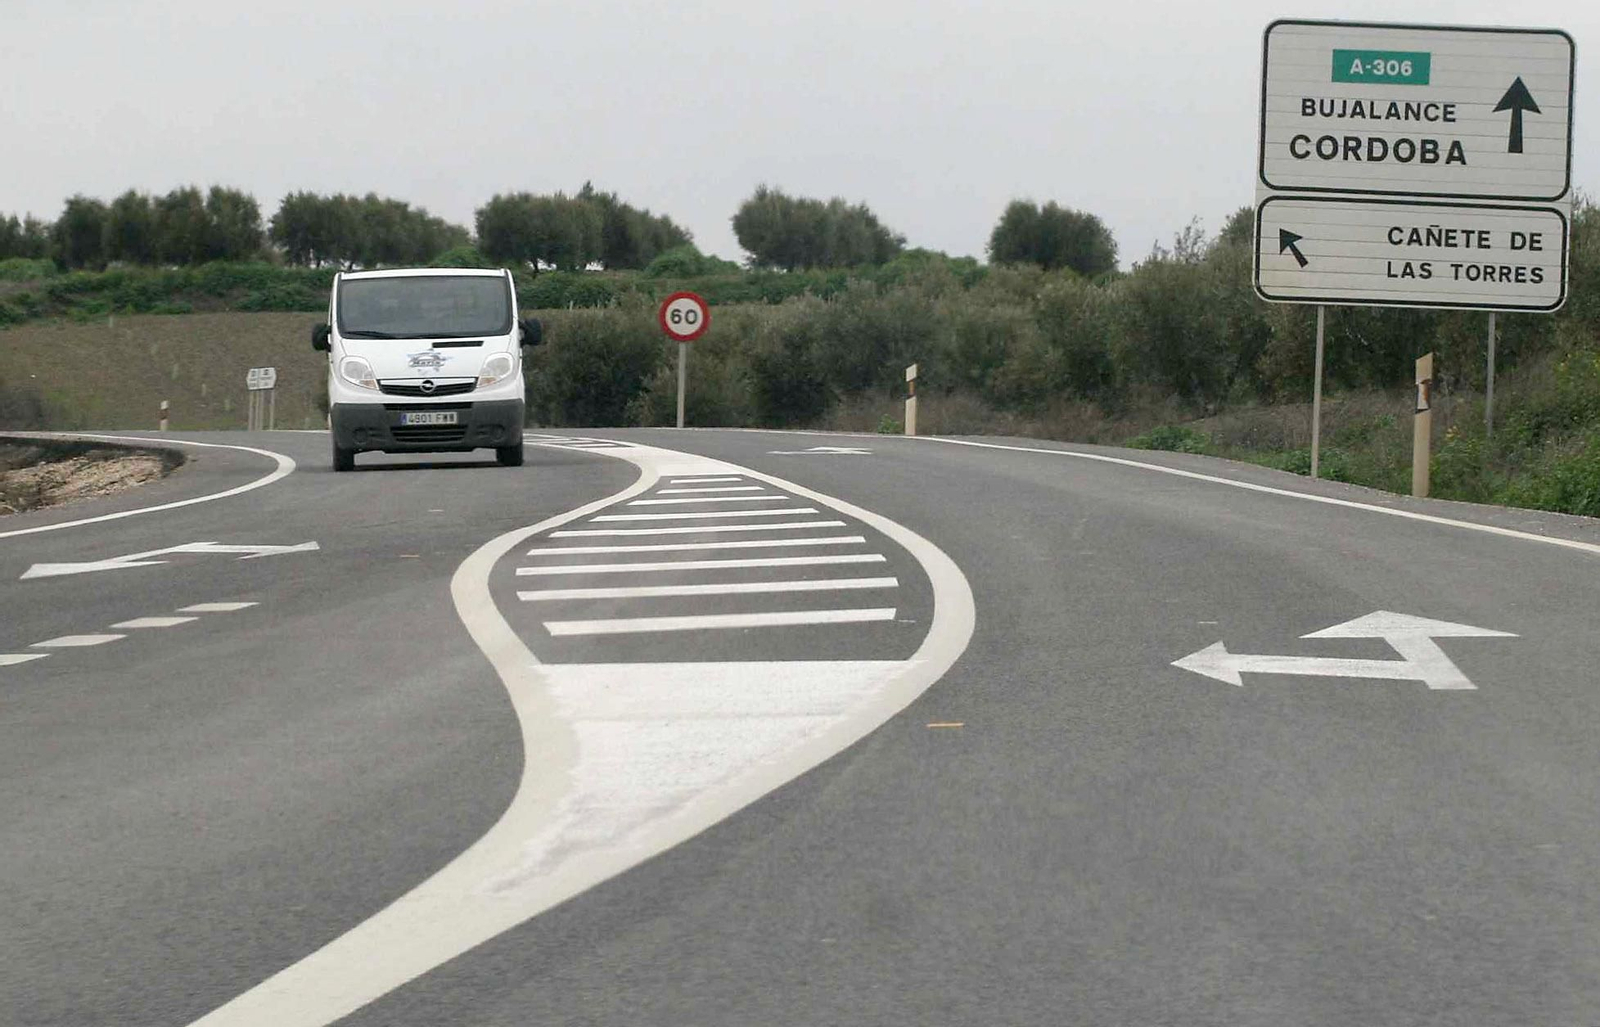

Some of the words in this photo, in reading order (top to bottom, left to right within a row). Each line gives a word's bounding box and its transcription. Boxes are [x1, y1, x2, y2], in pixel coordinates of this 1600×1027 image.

[1350, 58, 1413, 76] A-306
[1301, 98, 1456, 122] BUJALANCE
[1289, 134, 1467, 165] CORDOBA
[1387, 224, 1491, 249] CAÑETE
[1510, 231, 1543, 251] DE
[1387, 261, 1432, 279] LAS
[1450, 263, 1544, 284] TORRES
[671, 308, 698, 325] 60
